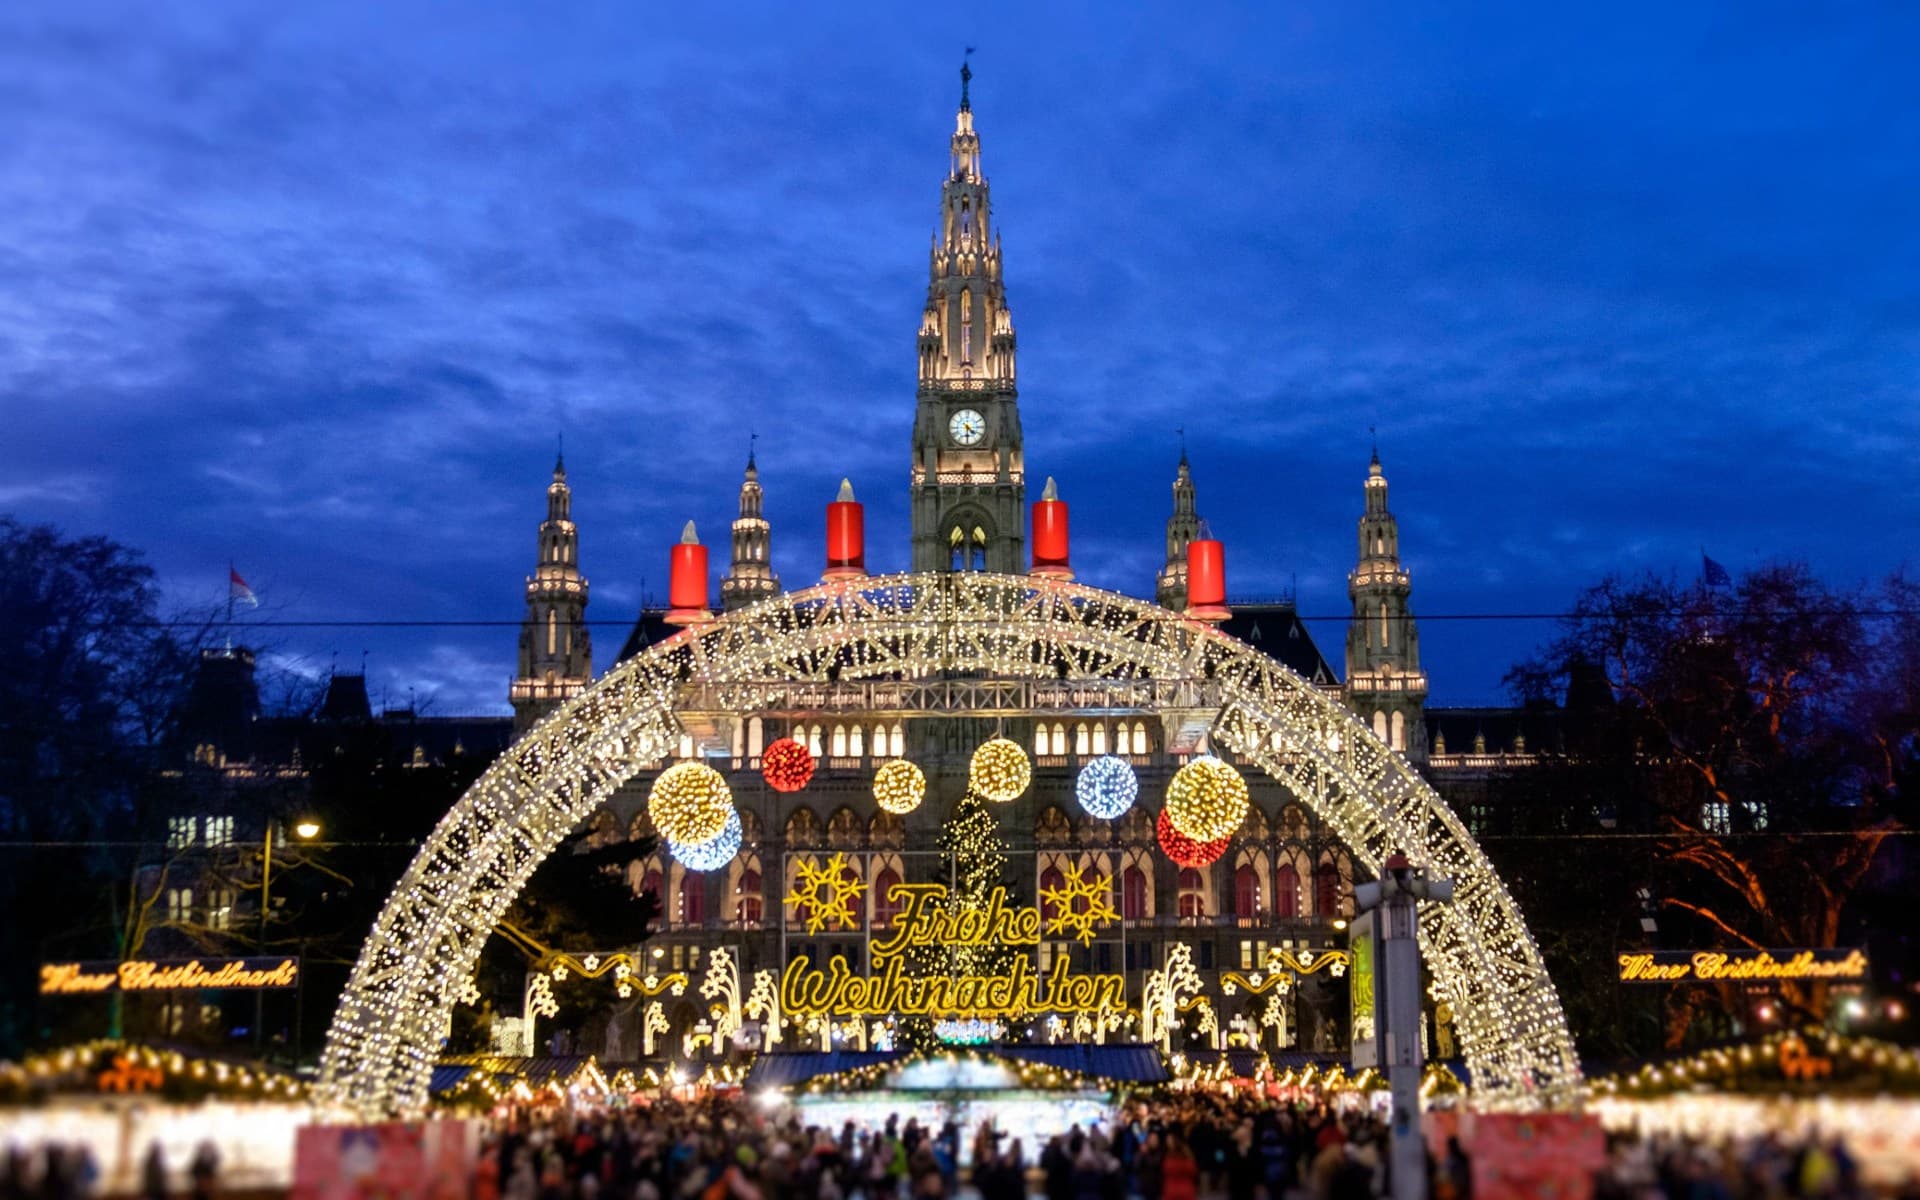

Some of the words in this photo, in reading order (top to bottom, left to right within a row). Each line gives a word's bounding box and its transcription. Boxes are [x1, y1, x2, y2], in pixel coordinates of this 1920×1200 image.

[870, 884, 1041, 957] Frohe
[40, 963, 116, 993] Wiener
[118, 960, 298, 989] Christkindlmarkt
[781, 956, 1126, 1015] Weihnachten
[1619, 953, 1690, 981] Wiener
[1692, 950, 1867, 979] Christkindlmarkt
